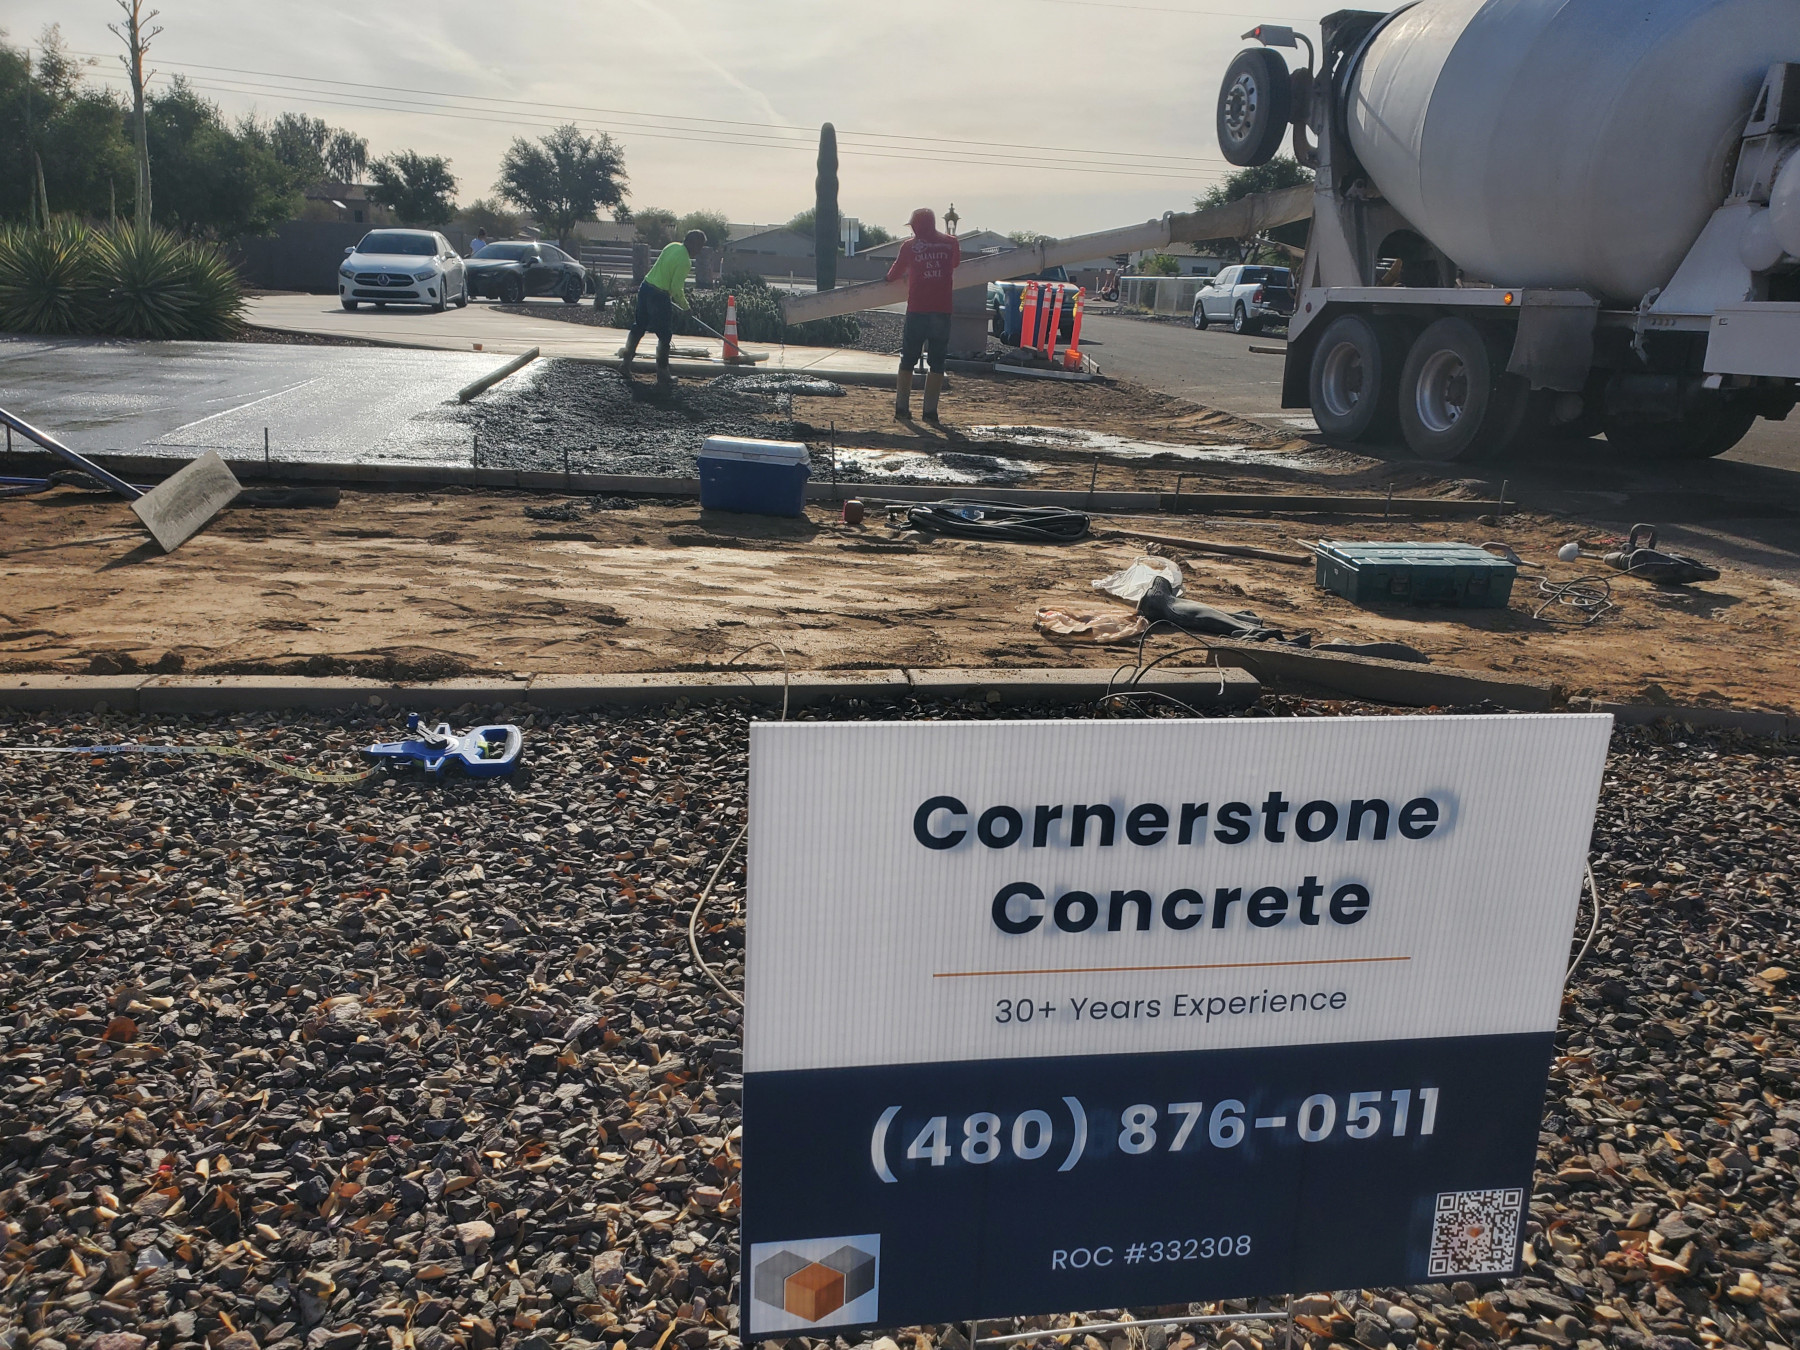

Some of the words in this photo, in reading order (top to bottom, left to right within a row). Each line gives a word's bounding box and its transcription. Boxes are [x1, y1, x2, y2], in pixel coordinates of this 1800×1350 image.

[915, 252, 948, 262] QUALITY
[923, 270, 942, 279] SKILL
[913, 791, 1439, 850] Cornerstone
[991, 875, 1371, 935] Concrete
[995, 998, 1057, 1024] 30+
[1070, 997, 1161, 1021] Years
[1173, 990, 1347, 1024] Experience
[870, 1096, 1088, 1184] (480)
[1118, 1087, 1439, 1154] 876-0511
[1052, 1246, 1114, 1270] ROC
[1123, 1235, 1251, 1264] #332308
